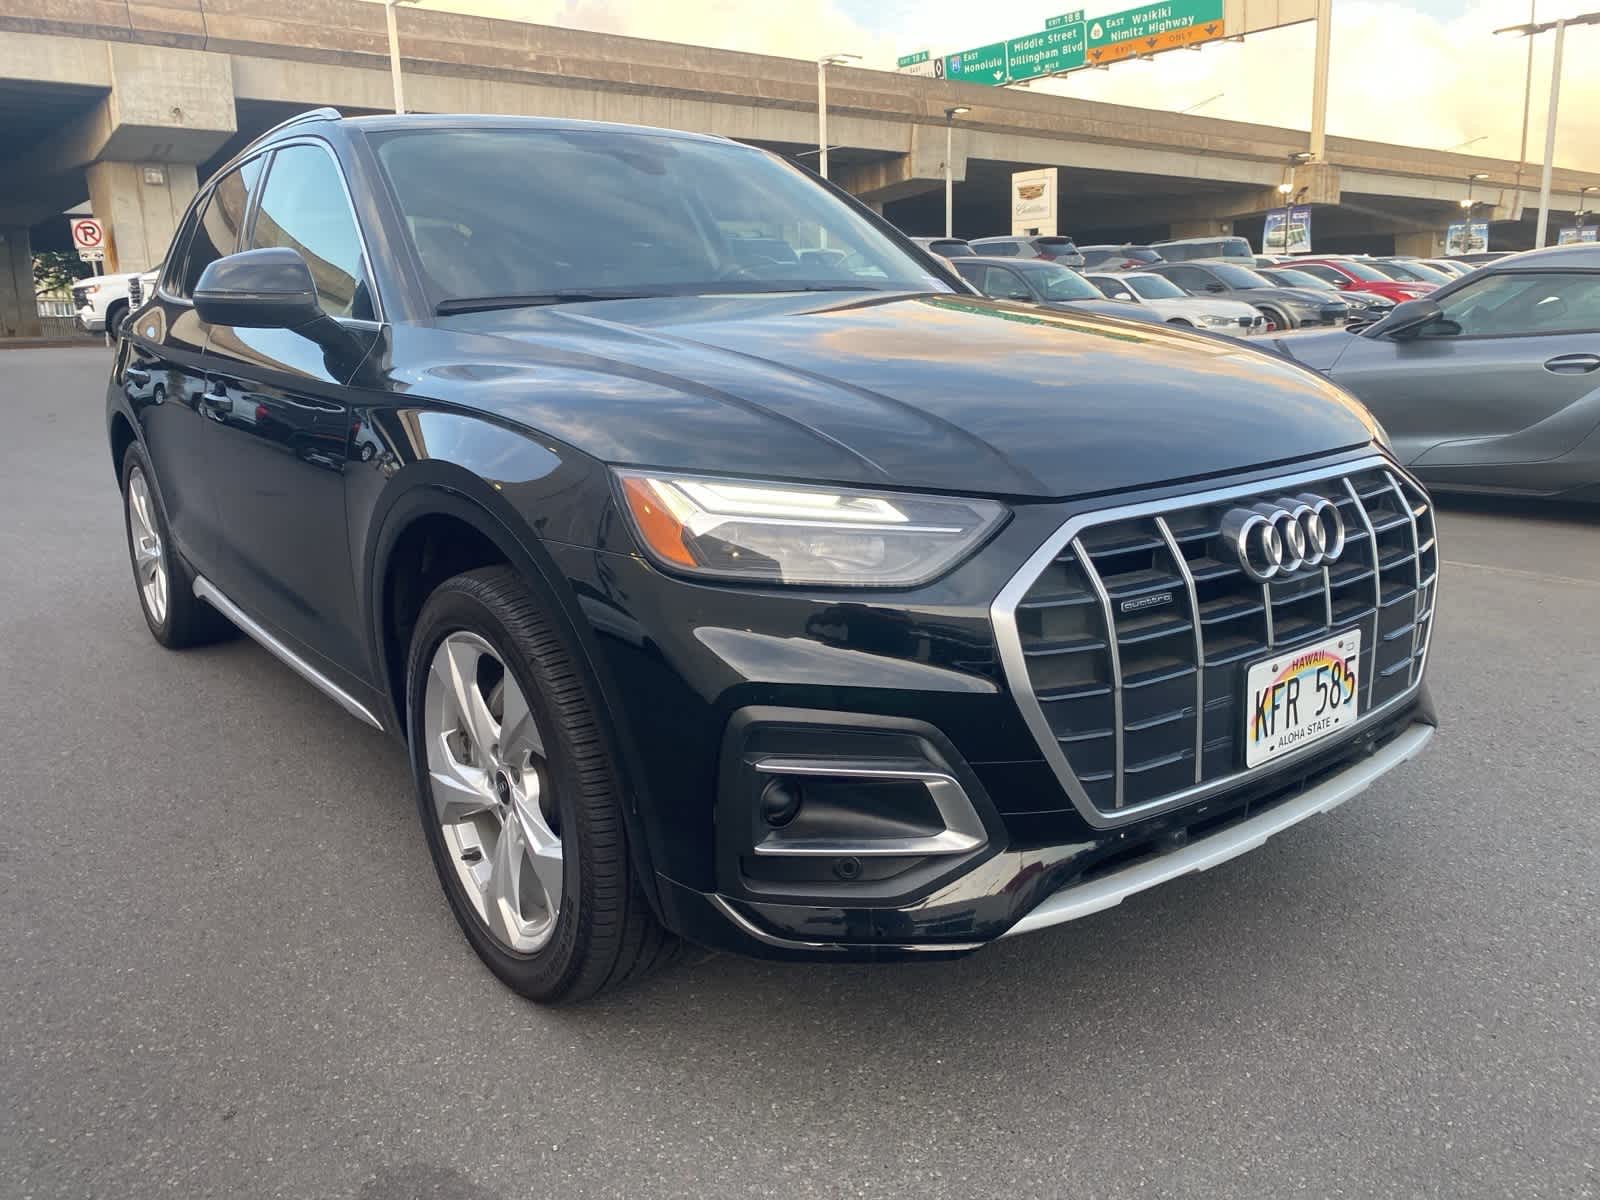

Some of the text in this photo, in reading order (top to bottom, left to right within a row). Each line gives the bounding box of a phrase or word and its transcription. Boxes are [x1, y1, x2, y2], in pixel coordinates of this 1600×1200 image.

[1131, 6, 1172, 25] Waikiki
[1111, 25, 1143, 41] Nimitz
[1149, 14, 1195, 33] Highway
[1168, 31, 1193, 42] ONLY
[1014, 37, 1044, 52] Middle
[1048, 29, 1077, 44] Street
[1010, 41, 1083, 66] Dillingham Blvd
[964, 58, 1002, 73] Honolulu
[1292, 650, 1325, 671] HAWAII
[1255, 655, 1356, 741] KFR 585
[1278, 716, 1331, 747] ALOHA STATE
